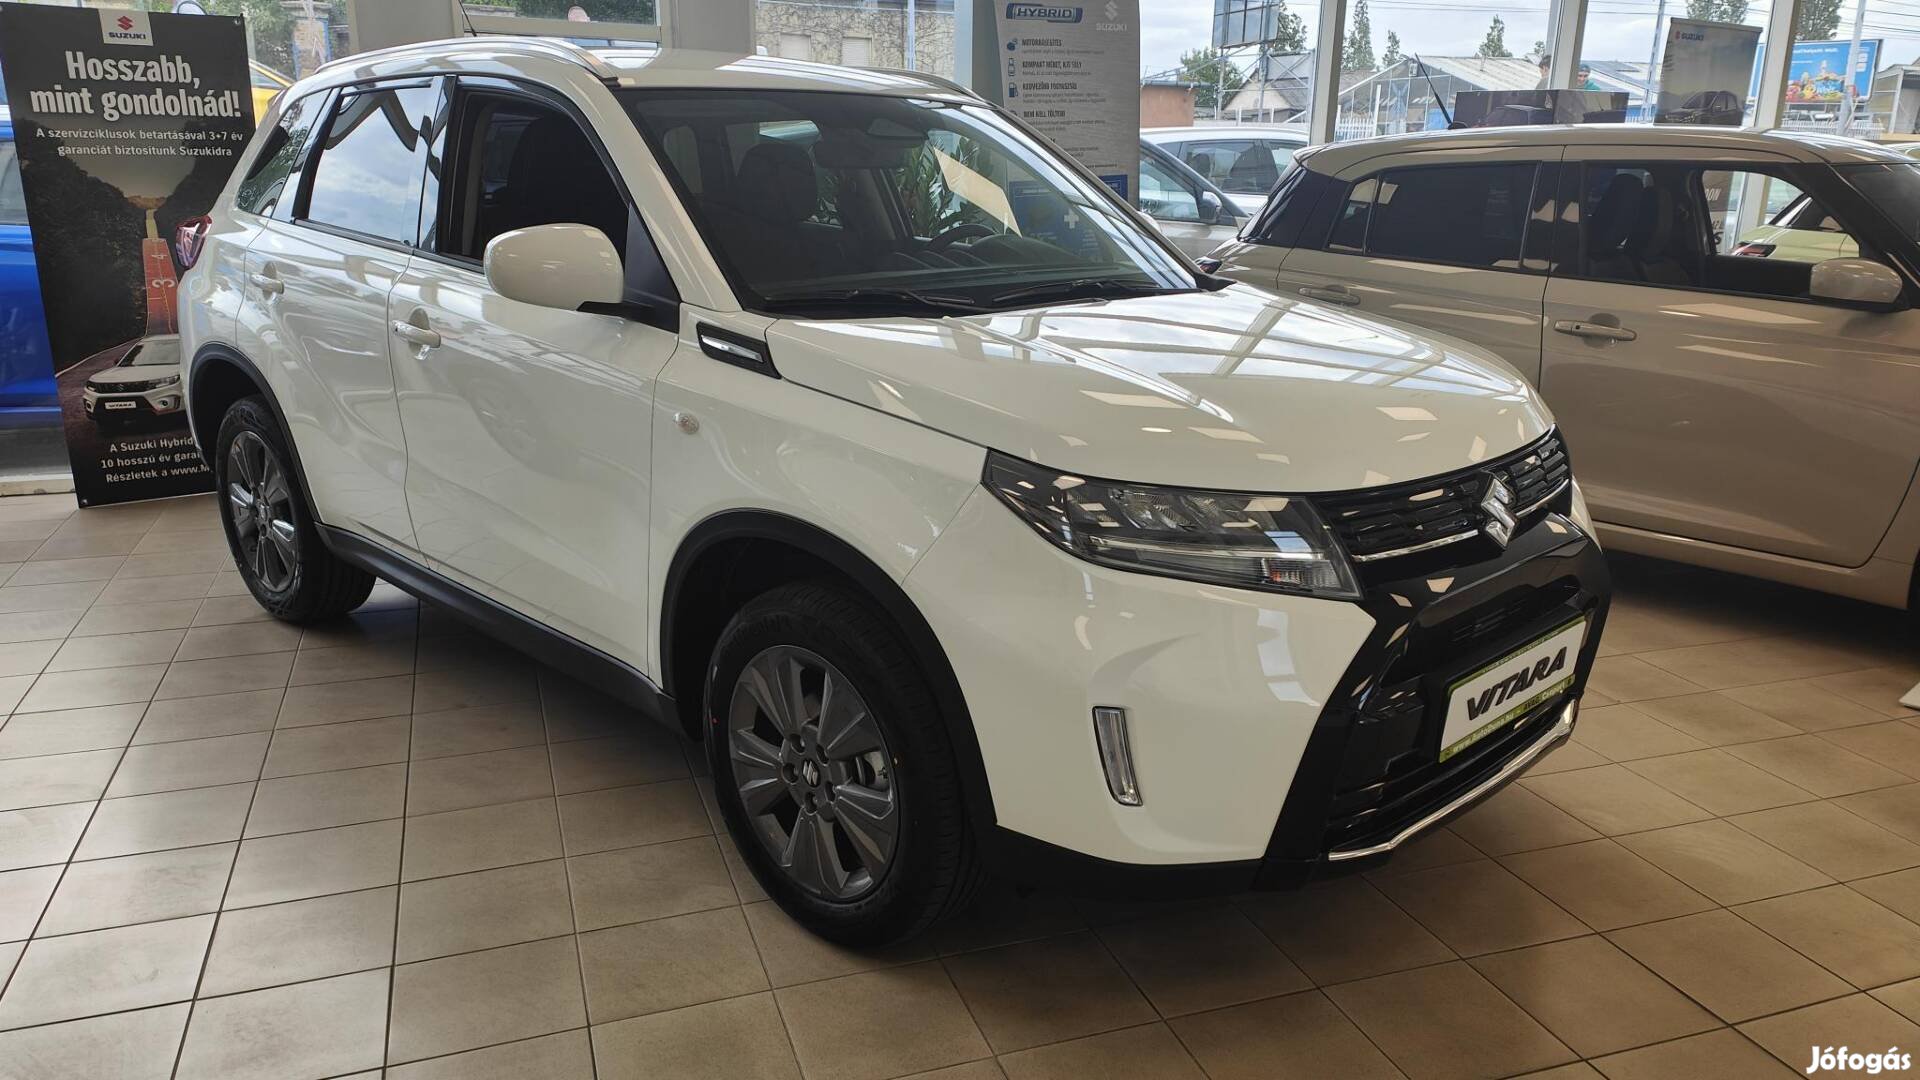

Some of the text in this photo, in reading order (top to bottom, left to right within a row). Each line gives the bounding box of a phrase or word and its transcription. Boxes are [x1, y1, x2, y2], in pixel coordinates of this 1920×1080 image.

[1017, 8, 1072, 18] HYBRID
[1096, 23, 1127, 31] SUZUKI
[108, 31, 146, 40] SUZUKI
[65, 51, 200, 89] Hosszabb,
[30, 84, 241, 121] mint gondolnád!
[36, 127, 243, 140] A szervizciklusok betartásával 3+7 év
[57, 145, 232, 157] garanciát biztosítunk Suzukidra
[110, 436, 193, 453] A Suzuki Hybrid
[100, 459, 114, 469] 10
[116, 455, 156, 467] hosszú
[158, 452, 171, 463] év
[105, 469, 158, 483] Részletek
[1467, 646, 1567, 720] VITARA
